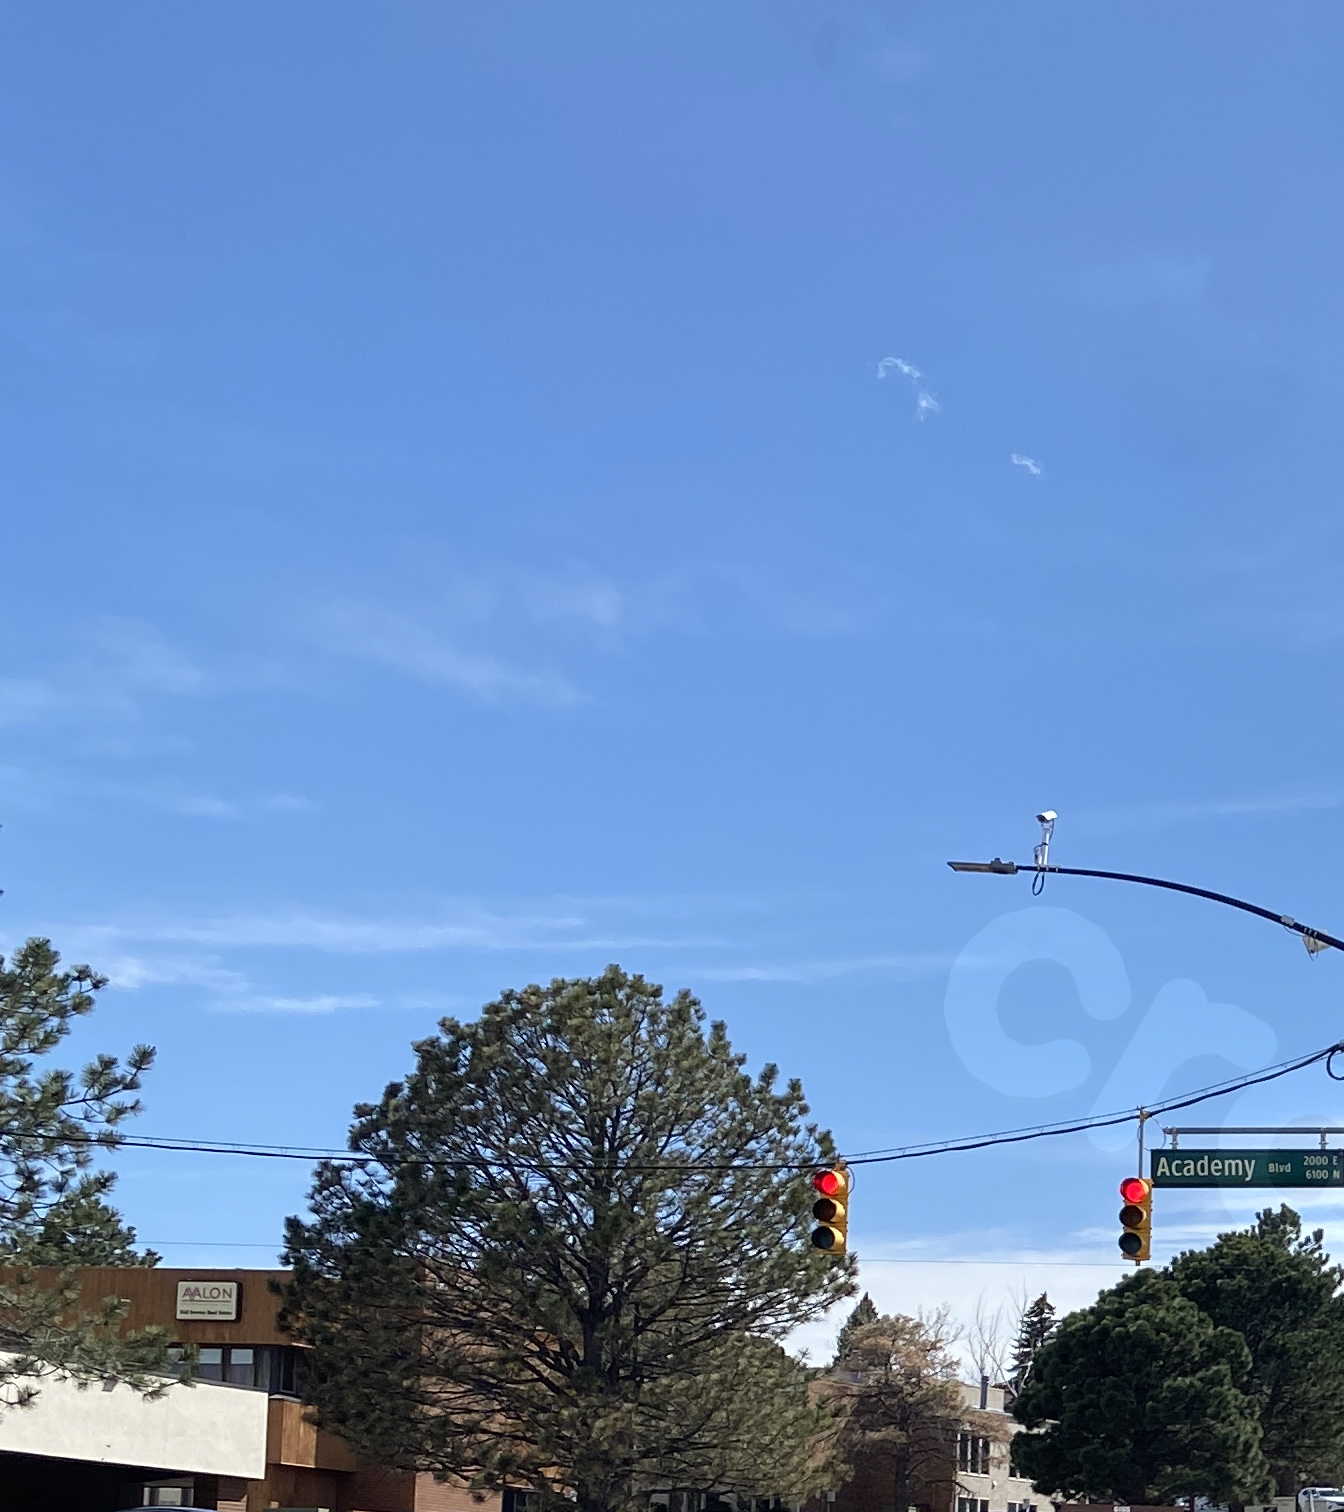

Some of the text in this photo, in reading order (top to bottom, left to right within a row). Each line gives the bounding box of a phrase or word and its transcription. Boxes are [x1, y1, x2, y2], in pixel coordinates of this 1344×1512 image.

[1303, 1156, 1339, 1166] 2000 E
[1156, 1156, 1292, 1182] Academy Blvd
[1305, 1170, 1341, 1180] 6100 N
[182, 1286, 232, 1301] AVALON
